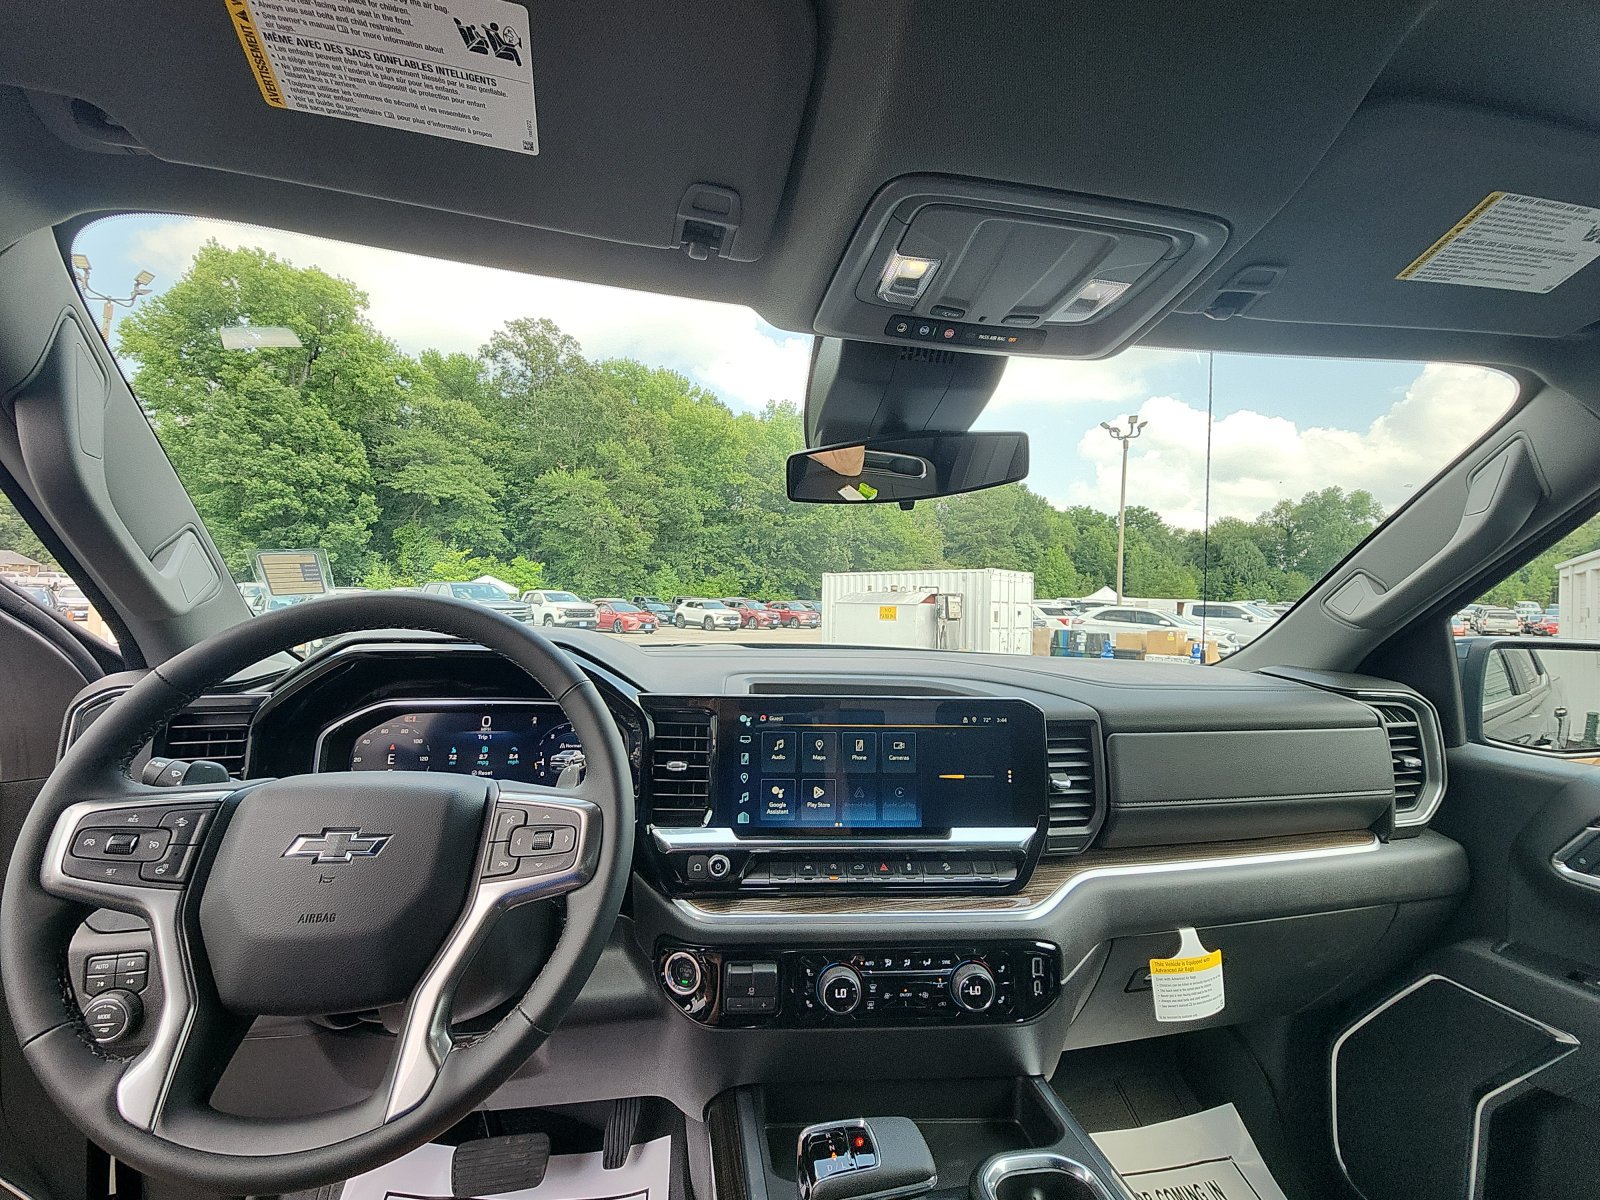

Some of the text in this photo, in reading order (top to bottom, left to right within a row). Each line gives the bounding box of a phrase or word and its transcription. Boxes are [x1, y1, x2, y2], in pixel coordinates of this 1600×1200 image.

[240, 24, 283, 105] AVERTISSEMENT
[262, 31, 498, 87] MÊME AVEC DES SACS GONFLABLES INTELLIGENTS
[387, 753, 396, 765] E
[298, 913, 336, 924] AIRBAG
[1204, 1180, 1228, 1200] IN
